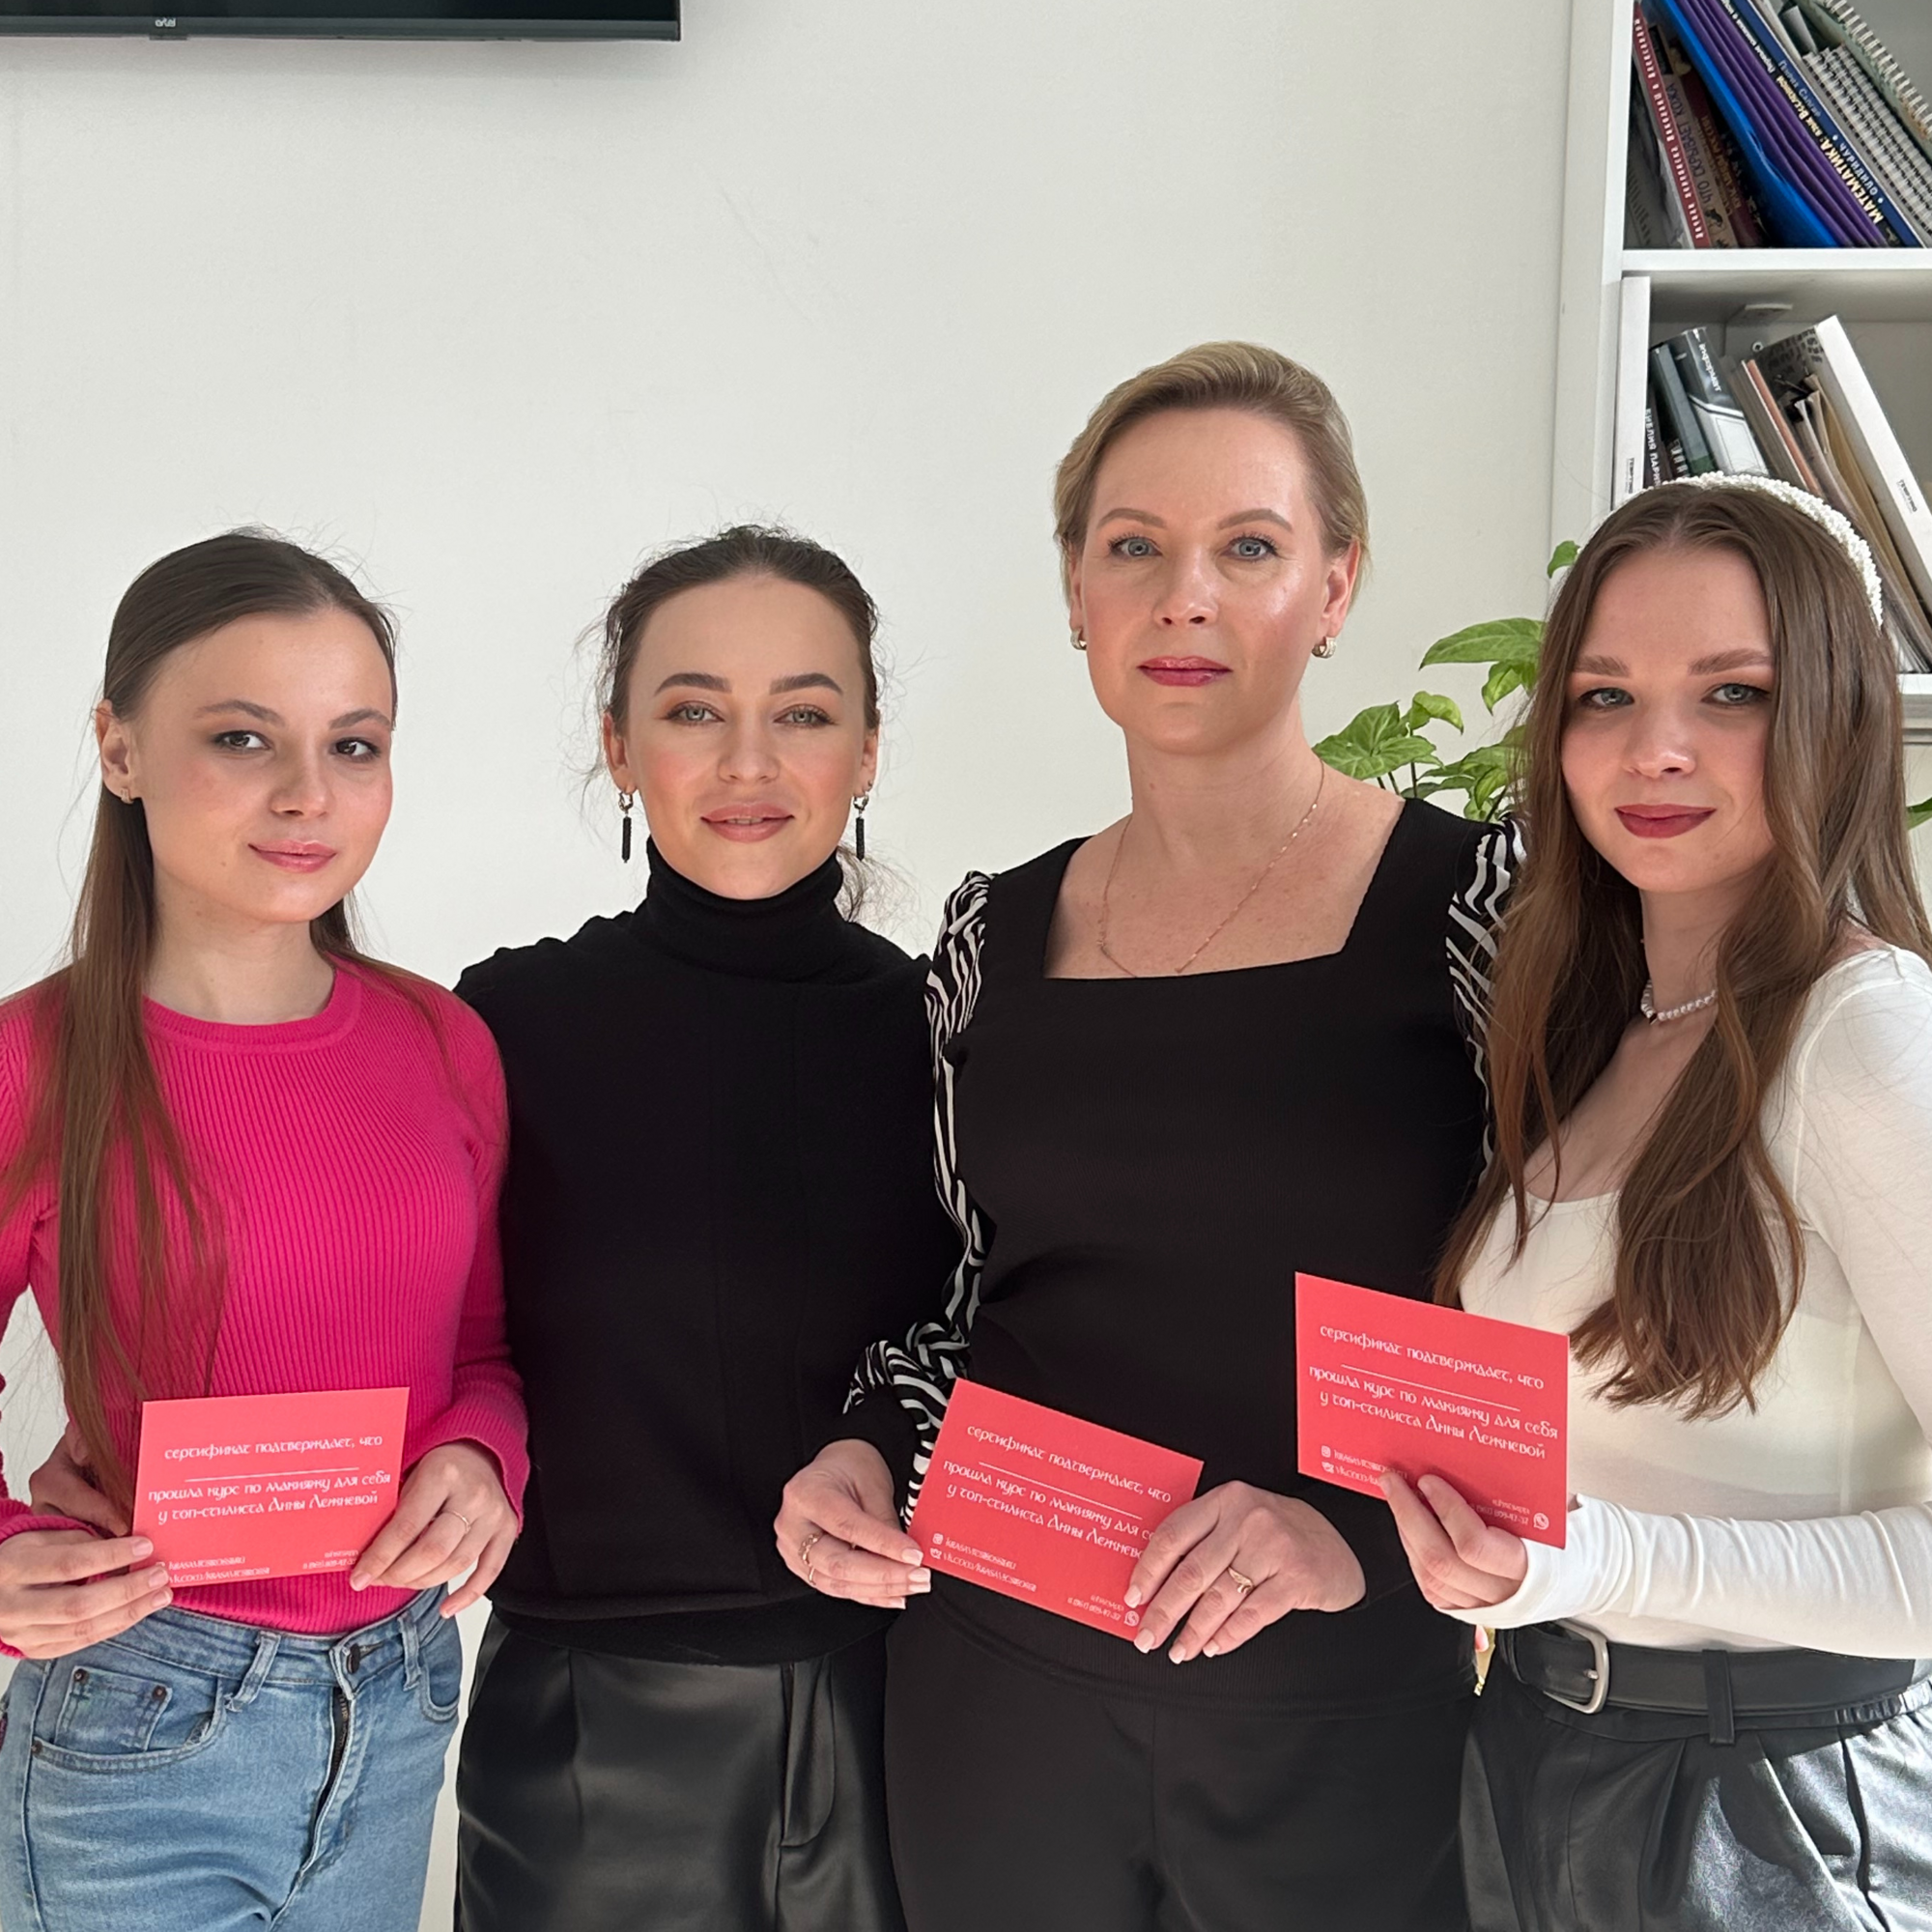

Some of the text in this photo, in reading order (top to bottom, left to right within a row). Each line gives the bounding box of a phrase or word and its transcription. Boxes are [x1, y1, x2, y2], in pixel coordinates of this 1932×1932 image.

[1321, 1325, 1544, 1390] сертификат подтверждает, что
[1310, 1366, 1558, 1439] прошла курс по макияжу для себя
[1321, 1391, 1546, 1460] у топ-стилиста Анны Лежневой
[164, 1435, 383, 1462] сертификат подтверждает, что
[967, 1425, 1171, 1503] сертификат подтверждает, что
[148, 1470, 391, 1504] прошла курс по макияжу для себя
[157, 1491, 378, 1525] у топ-стилиста Анны Лежневой
[944, 1461, 992, 1486] прошла
[996, 1479, 1026, 1499] курс
[1030, 1490, 1046, 1503] по
[1049, 1497, 1112, 1529] макияжу
[1114, 1520, 1139, 1535] для
[947, 1485, 956, 1498] у
[959, 1487, 1044, 1525] топ-стилиста
[1047, 1514, 1083, 1539] Анны
